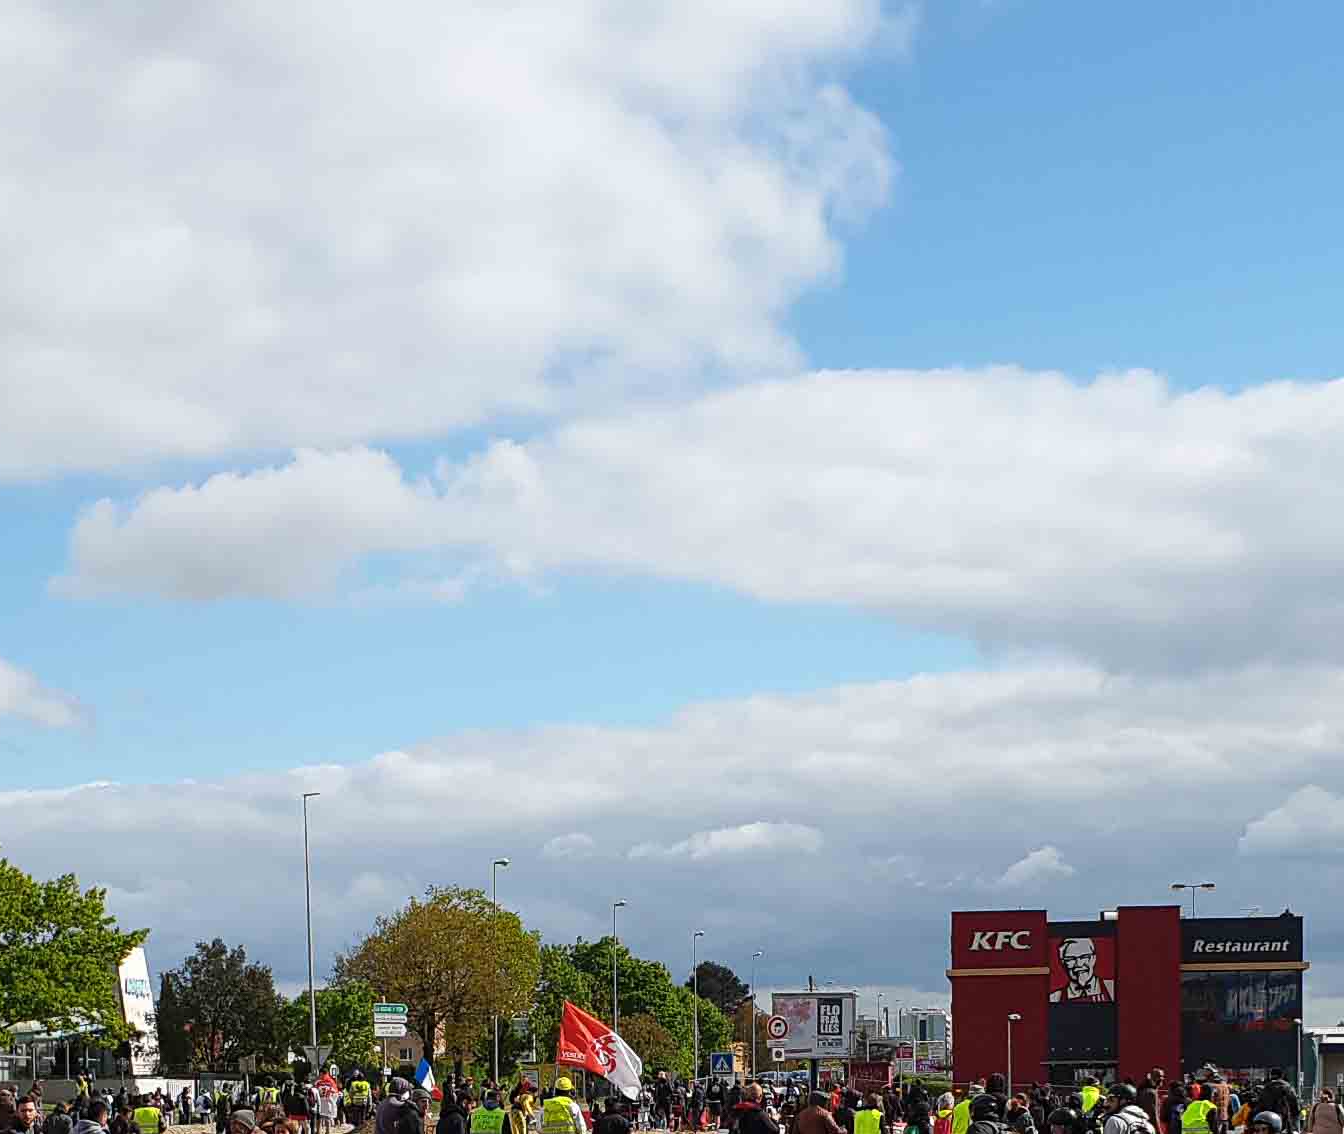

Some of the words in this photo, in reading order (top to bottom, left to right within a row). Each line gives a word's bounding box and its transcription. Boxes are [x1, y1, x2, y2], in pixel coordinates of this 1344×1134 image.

[969, 931, 1032, 951] KFC
[1192, 939, 1290, 953] Restaurant
[820, 1004, 840, 1016] FLO
